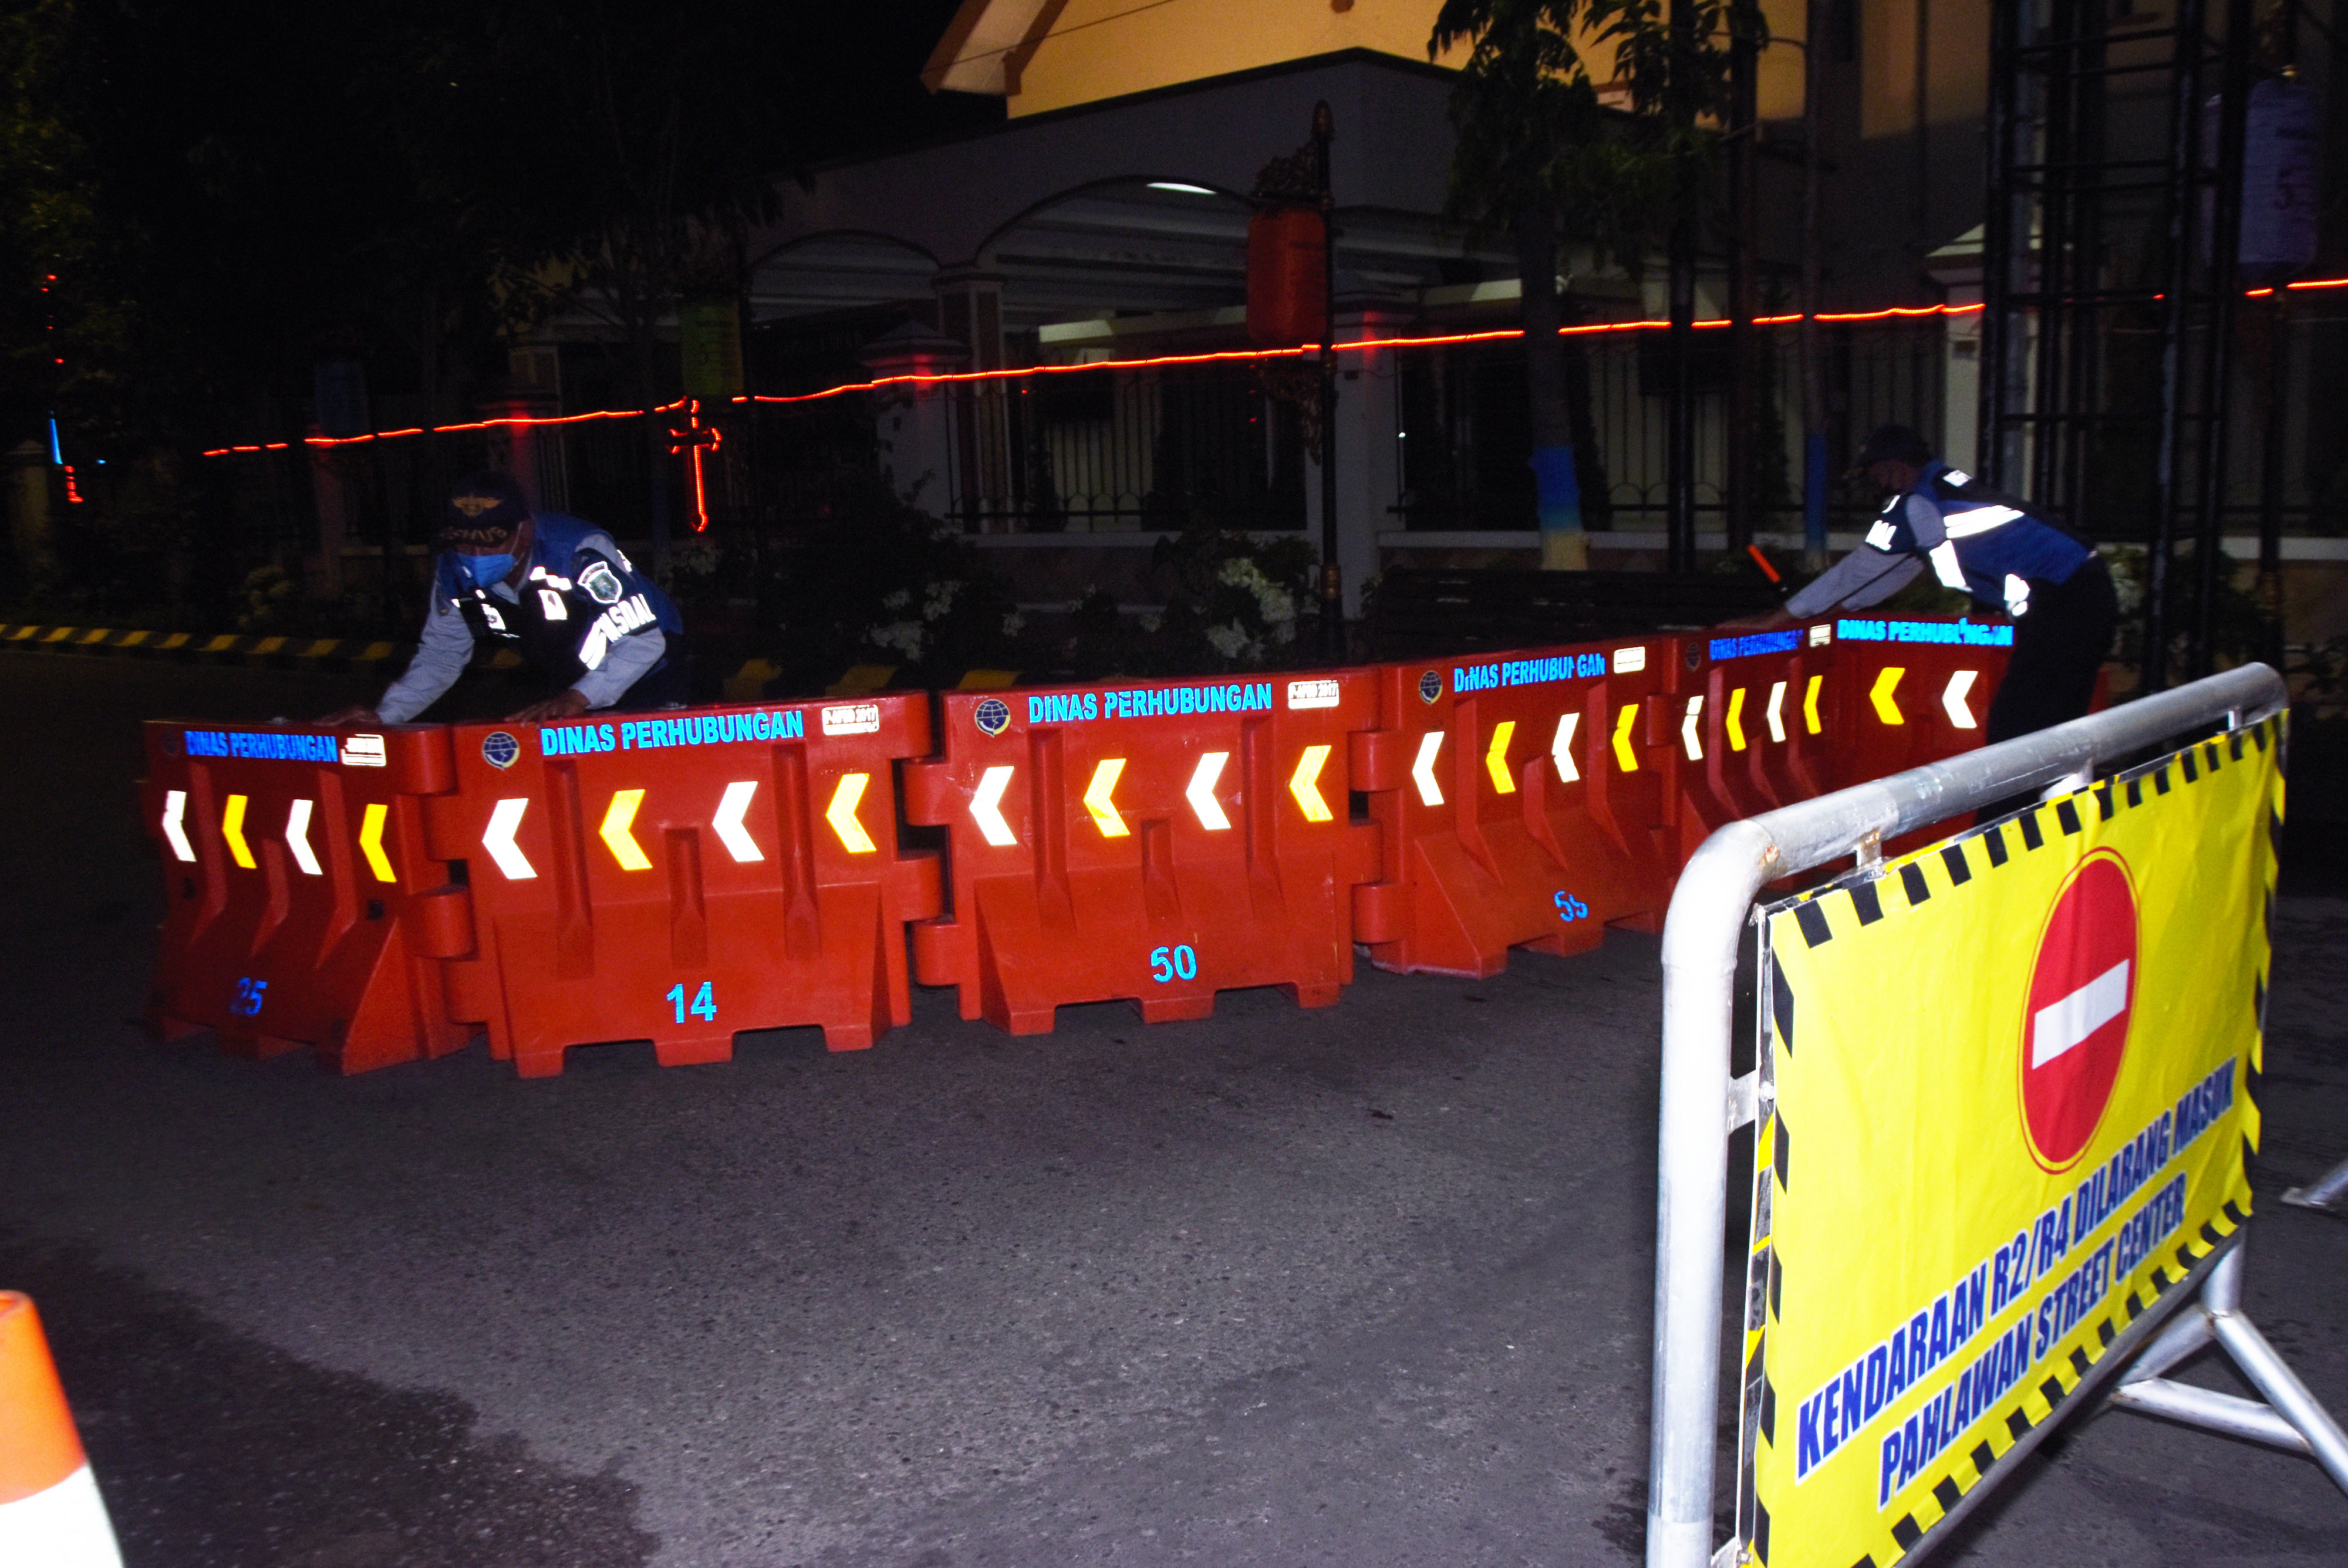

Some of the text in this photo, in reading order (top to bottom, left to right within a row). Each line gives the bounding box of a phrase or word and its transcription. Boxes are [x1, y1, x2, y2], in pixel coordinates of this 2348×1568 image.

[1837, 619, 1887, 641] DINAS
[1028, 683, 1273, 724] DINAS PERHUBUNGAN
[184, 731, 227, 758] DINAS
[228, 732, 339, 763] PERHUBUNGAN
[540, 710, 805, 757] DINAS PERHUBUNGAN
[1151, 944, 1197, 983] 50
[231, 977, 268, 1016] 25
[666, 981, 717, 1024] 14
[1797, 1056, 2236, 1480] KENDARAAN R2/R4 DILARANG MASUK
[1880, 1172, 2186, 1508] PAHLAWAN STREET CENTER
